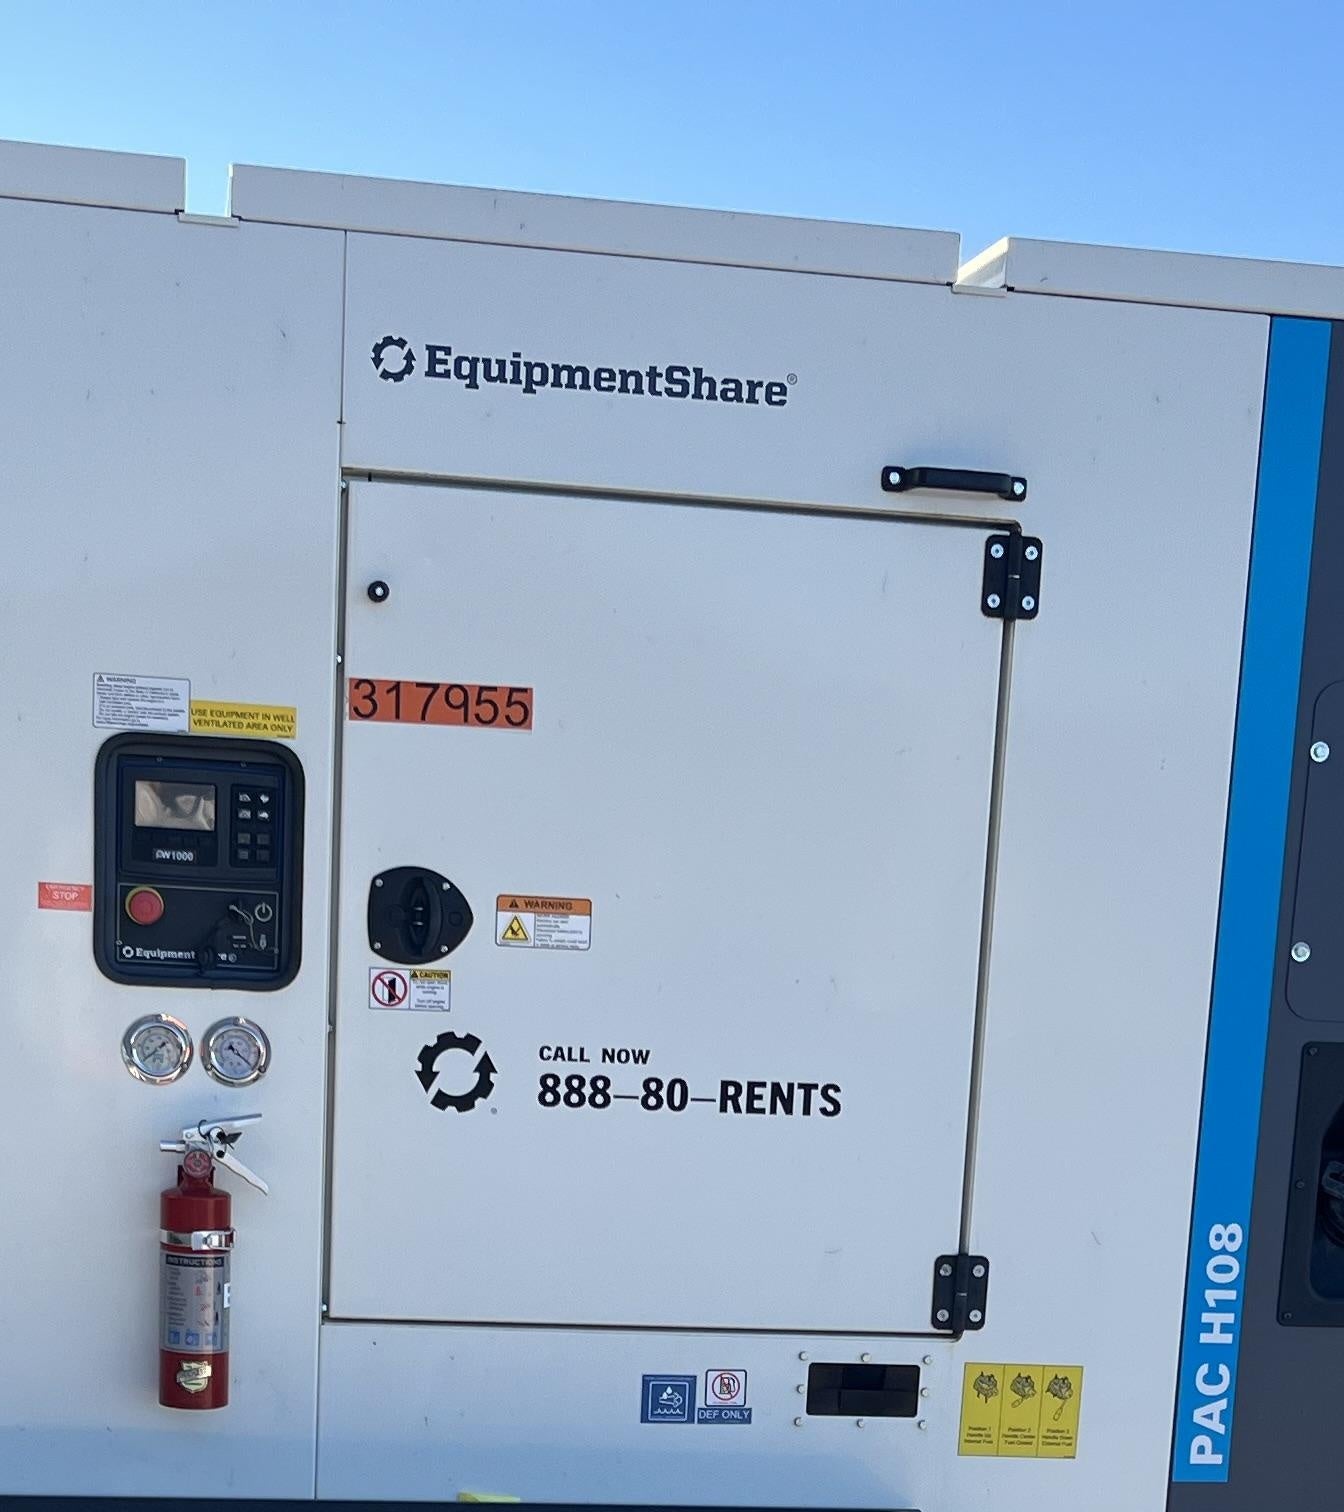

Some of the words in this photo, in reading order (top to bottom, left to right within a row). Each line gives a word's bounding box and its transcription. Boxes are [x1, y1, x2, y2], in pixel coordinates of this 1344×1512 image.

[353, 679, 530, 727] 317955
[191, 708, 207, 717] USE
[210, 709, 259, 720] EQUIPMENT
[262, 712, 271, 721] IN
[273, 713, 295, 723] WELL
[192, 718, 244, 730] VENTILATED
[245, 722, 269, 731] AREA
[270, 723, 294, 733] ONLY
[52, 890, 79, 900] STOP
[523, 899, 573, 911] WARNING
[419, 971, 449, 979] CAUTION
[539, 1045, 591, 1063] CALL
[601, 1047, 651, 1066] NOW
[1199, 1222, 1244, 1345] H108
[698, 1410, 719, 1419] DEF
[721, 1410, 750, 1420] ONLY
[1189, 1362, 1231, 1465] PAC
